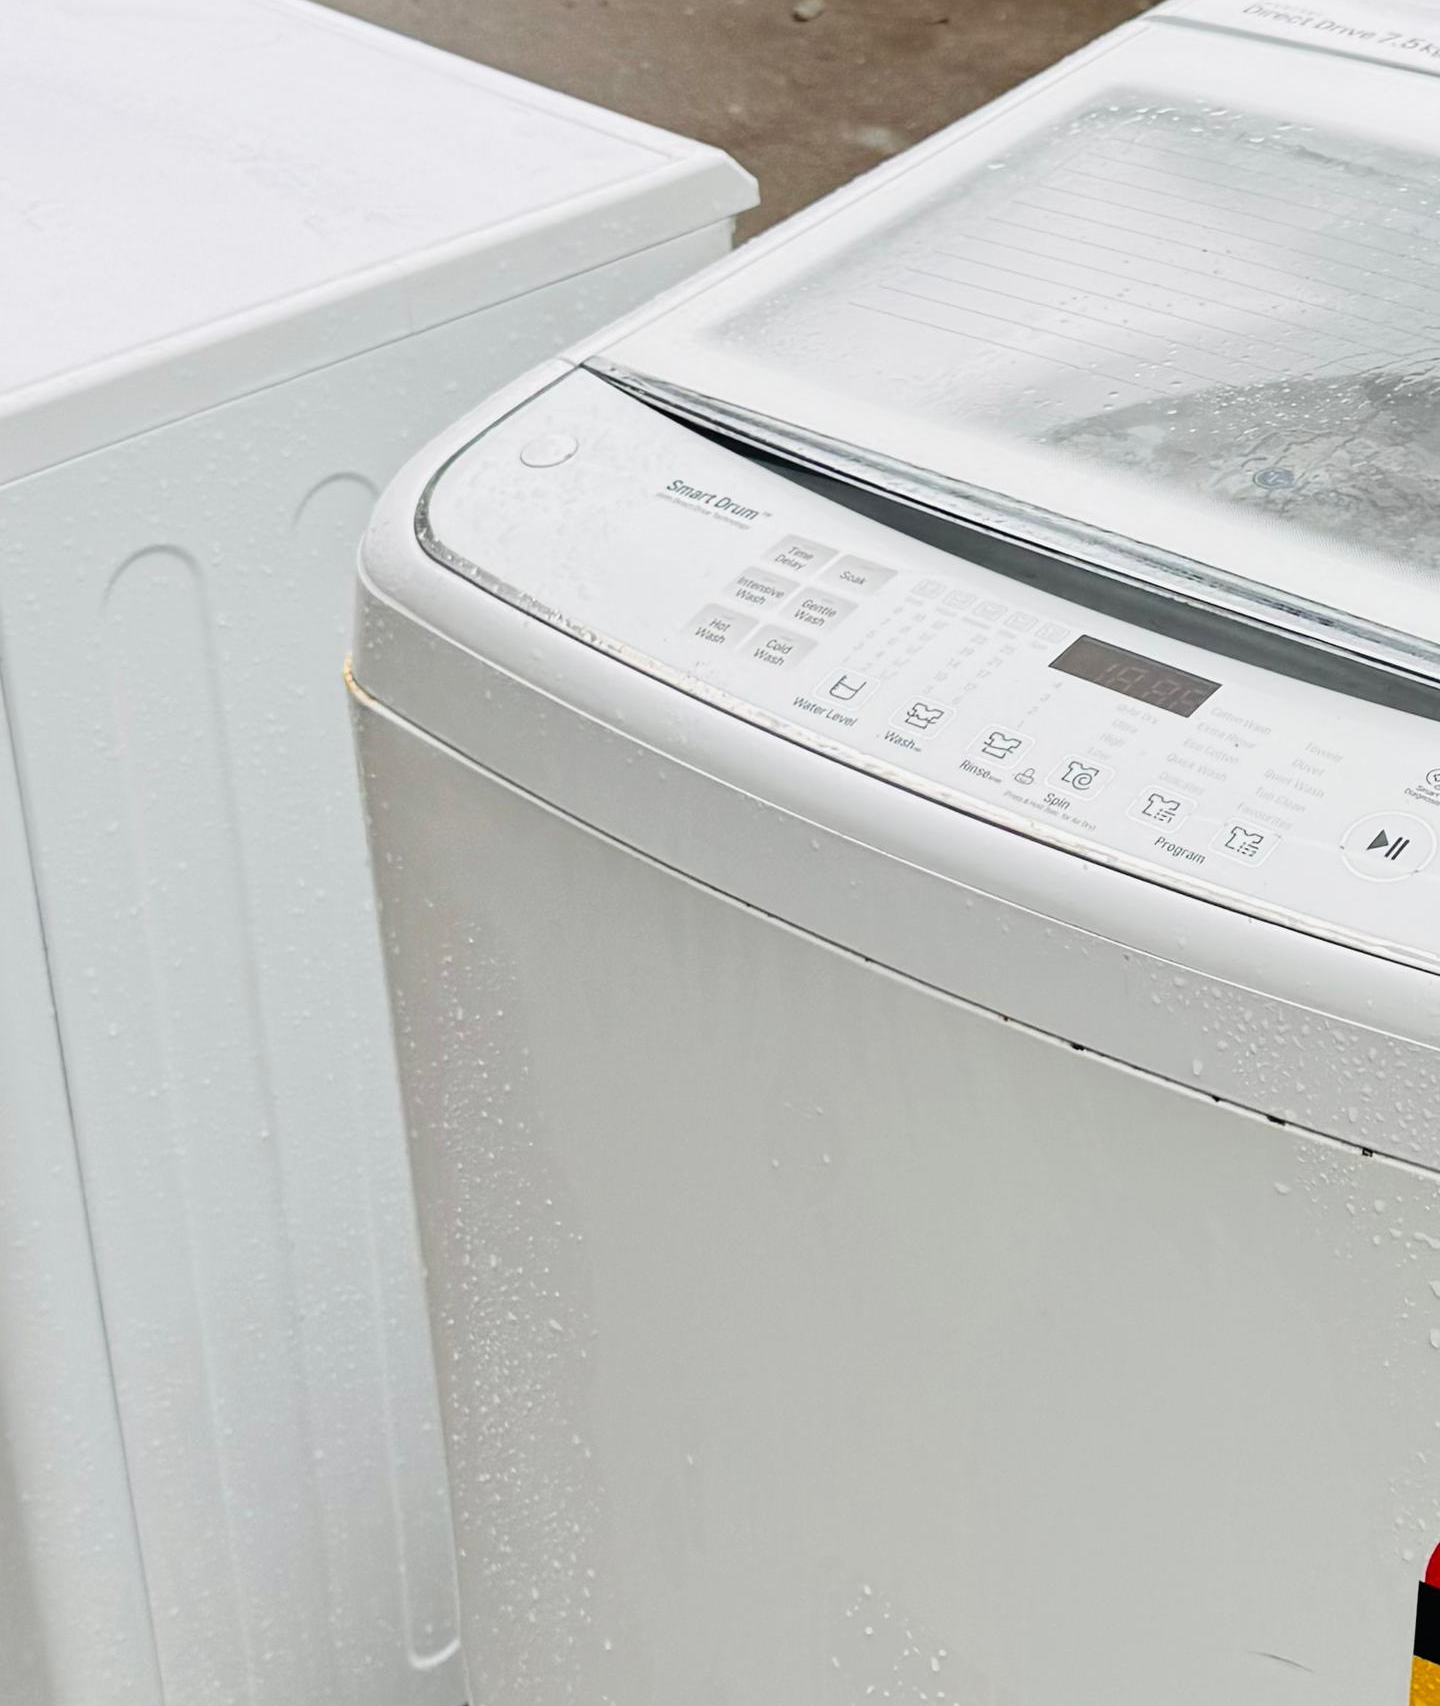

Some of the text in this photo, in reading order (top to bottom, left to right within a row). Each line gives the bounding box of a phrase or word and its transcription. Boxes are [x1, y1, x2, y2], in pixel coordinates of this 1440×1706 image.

[1240, 2, 1316, 27] Direct
[1312, 17, 1377, 41] Drive
[666, 477, 717, 508] Smart
[774, 553, 807, 572] Delay
[839, 569, 868, 587] Soak
[735, 587, 767, 606] Wash
[793, 608, 826, 628] Wash
[801, 598, 838, 619] Gentle
[708, 617, 732, 633] Hot
[694, 625, 727, 646] Wash
[765, 638, 793, 655] Cold
[753, 647, 786, 667] Wash
[792, 695, 860, 729] Water Level
[1243, 718, 1272, 736] Wash
[1203, 745, 1239, 765] Cotton
[1197, 764, 1227, 782] Wash
[1294, 779, 1325, 798] Wash
[1043, 792, 1071, 811] Spin
[1153, 834, 1207, 866] Program
